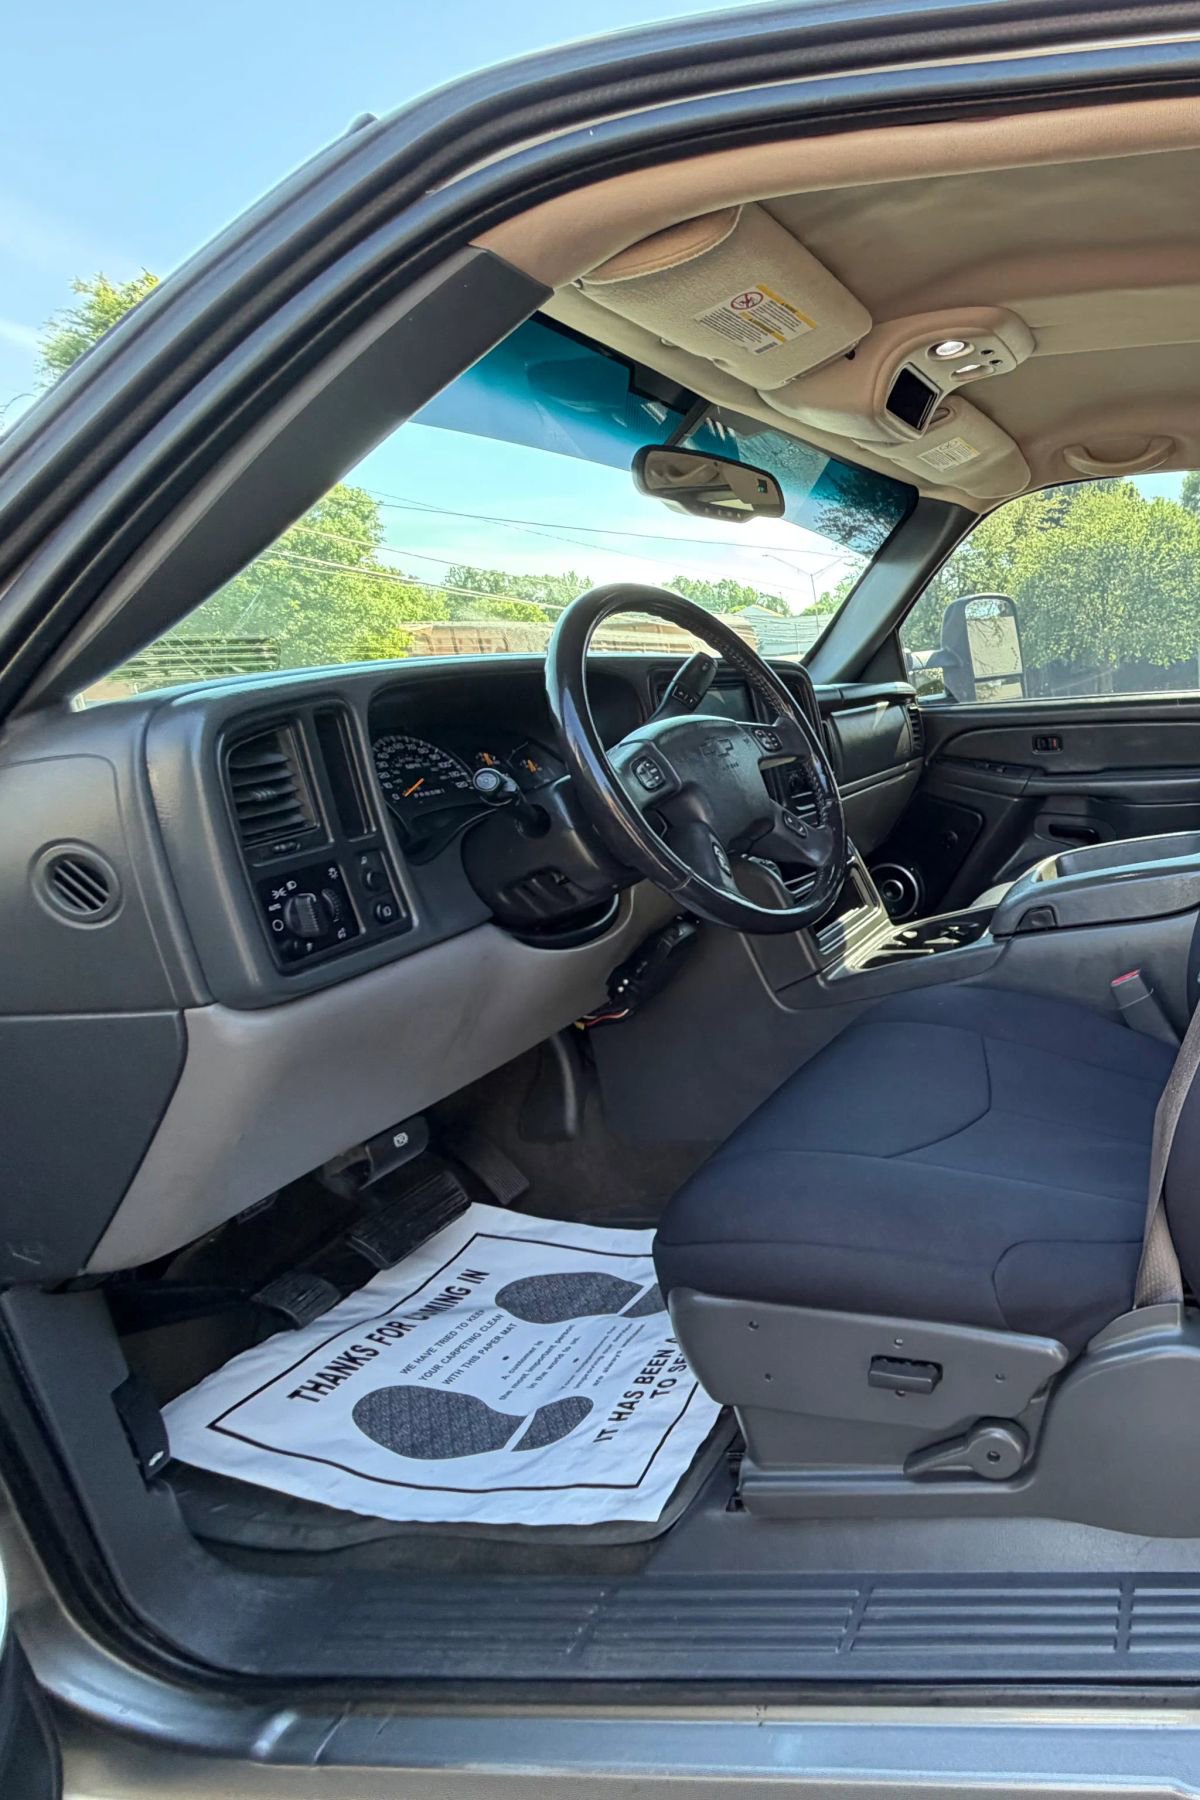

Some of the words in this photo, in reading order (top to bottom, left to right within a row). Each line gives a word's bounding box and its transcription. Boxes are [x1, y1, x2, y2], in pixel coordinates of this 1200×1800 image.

[286, 1344, 380, 1403] THANKS
[365, 1320, 417, 1346] FOR
[402, 1285, 472, 1321] CMING
[456, 1268, 490, 1285] IN
[399, 1362, 417, 1375] WE
[413, 1347, 438, 1364] HAVE
[433, 1330, 458, 1348] TRIED
[455, 1322, 469, 1331] TO
[418, 1363, 444, 1381] YOUR
[440, 1332, 482, 1364] CARPETING
[479, 1313, 505, 1333] CLEAN
[442, 1369, 465, 1385] WITH
[460, 1355, 481, 1370] THIS
[478, 1335, 504, 1355] PAPER
[500, 1322, 518, 1336] MAT
[592, 1428, 620, 1443] IT
[607, 1390, 645, 1422] HAS
[632, 1349, 676, 1385] BEEN
[649, 1378, 678, 1399] TO
[667, 1353, 687, 1373] SE
